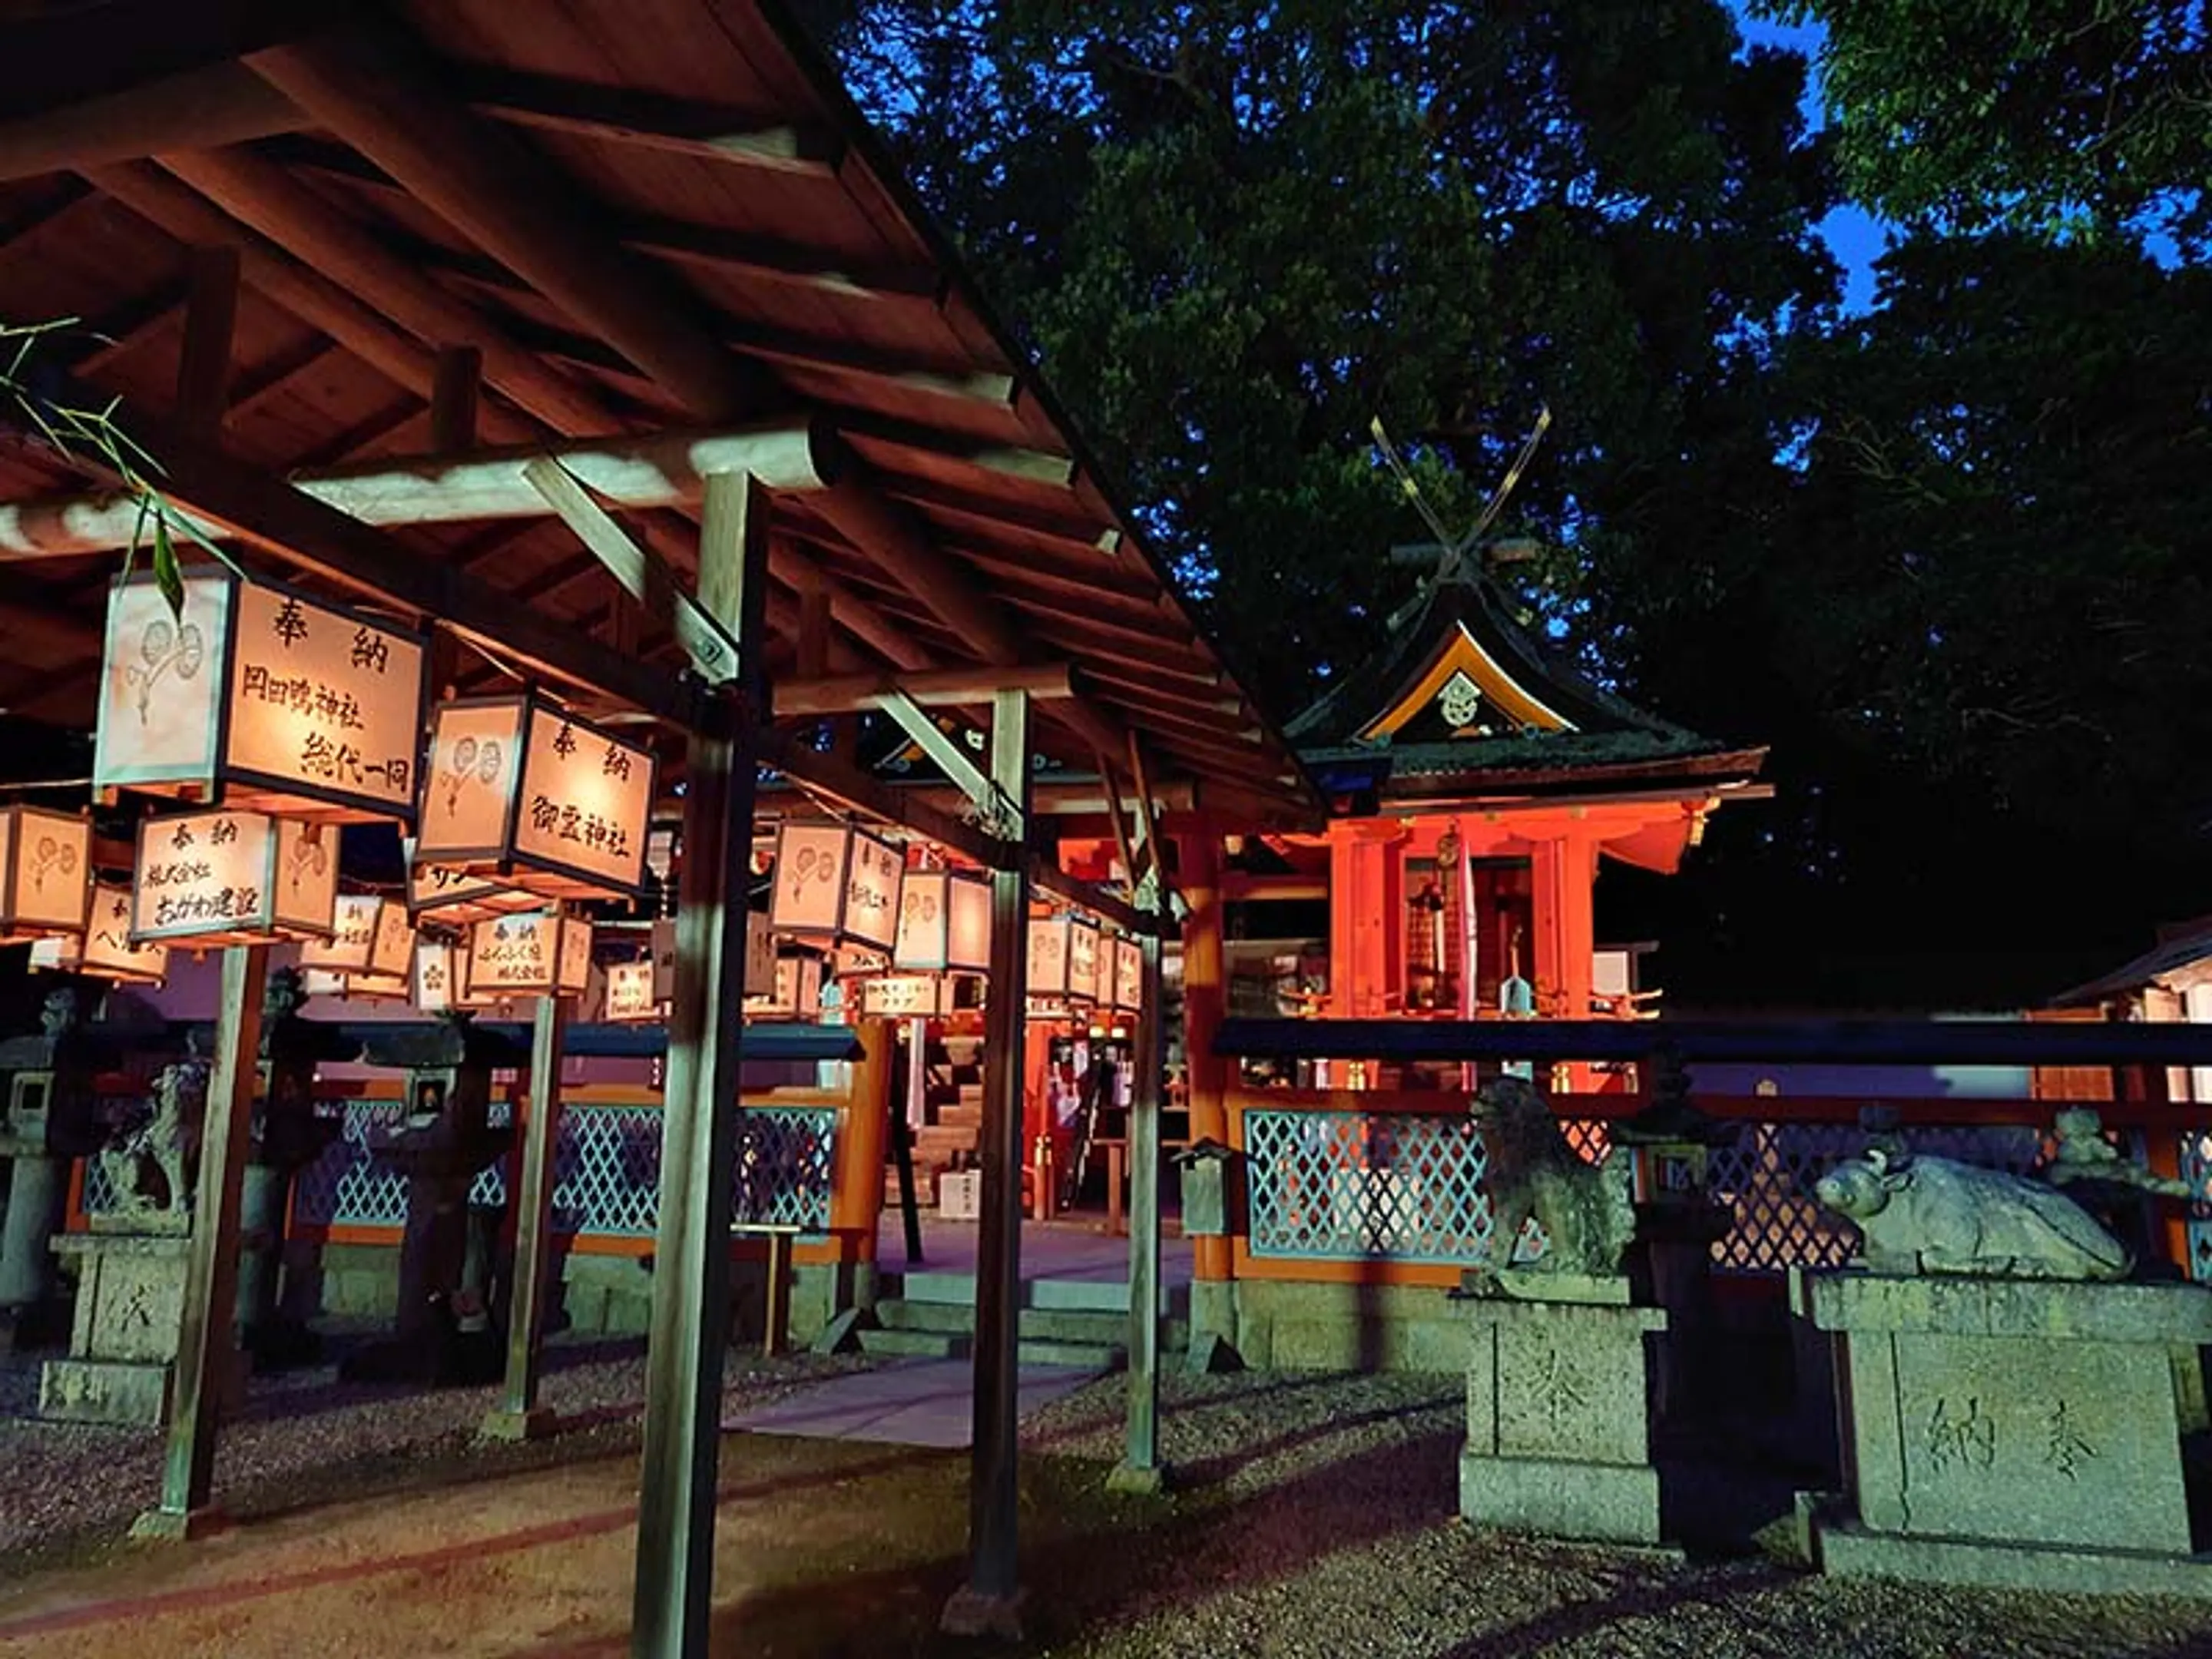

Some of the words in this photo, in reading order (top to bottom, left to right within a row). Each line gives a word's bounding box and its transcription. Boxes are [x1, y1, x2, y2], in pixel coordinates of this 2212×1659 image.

[273, 596, 389, 674] 奉納
[300, 731, 409, 792] 総代一同
[552, 724, 632, 782] 奉納
[171, 819, 238, 849] 奉納
[531, 795, 631, 858] 御霊神社
[142, 861, 211, 888] 株式会社
[154, 887, 259, 926] おがわ建設
